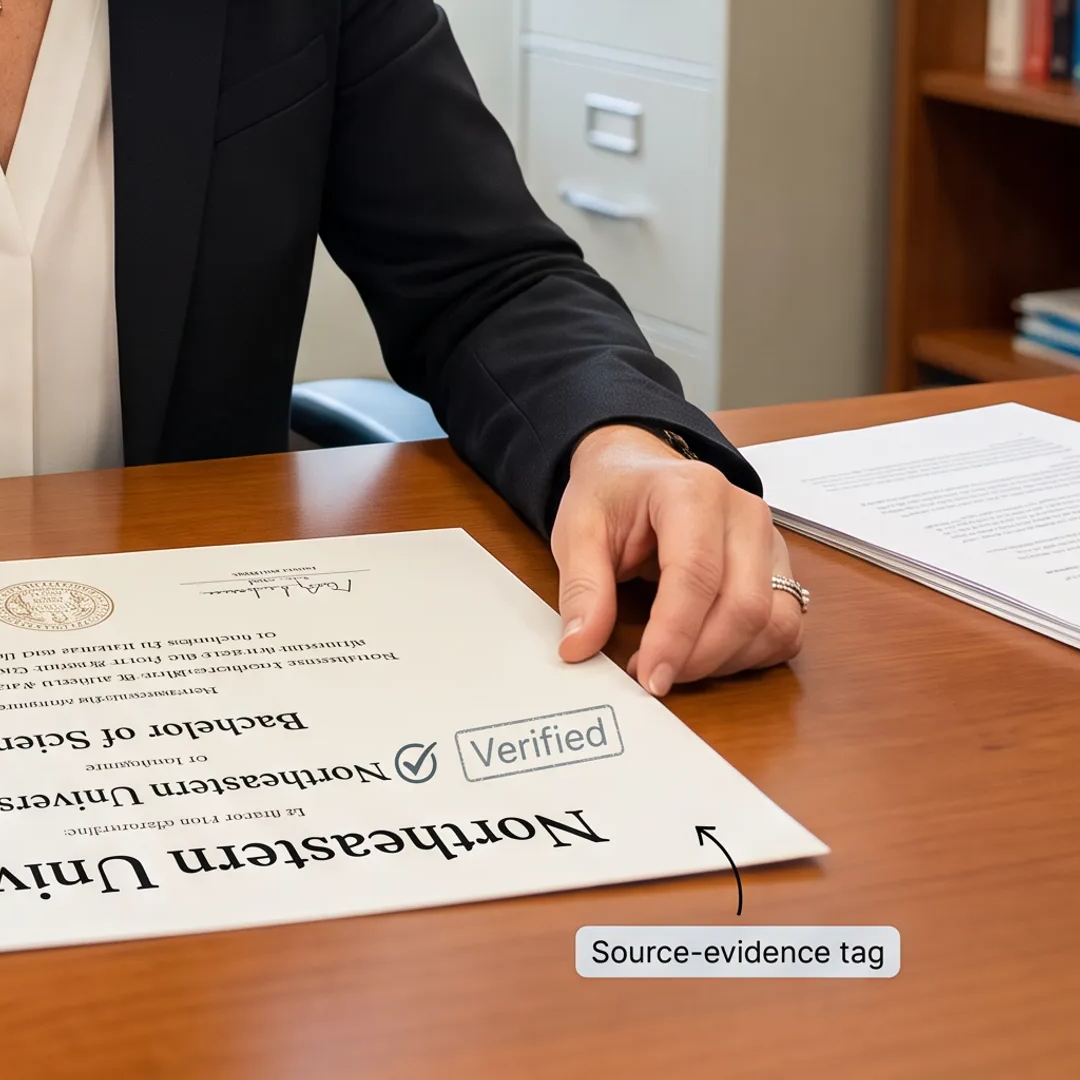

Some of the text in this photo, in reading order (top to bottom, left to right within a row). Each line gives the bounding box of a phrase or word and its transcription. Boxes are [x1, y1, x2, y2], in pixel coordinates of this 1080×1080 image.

[100, 726, 136, 749] of
[148, 712, 309, 740] Bachelor
[149, 762, 392, 797] Northeastern
[166, 809, 610, 874] Northeastern
